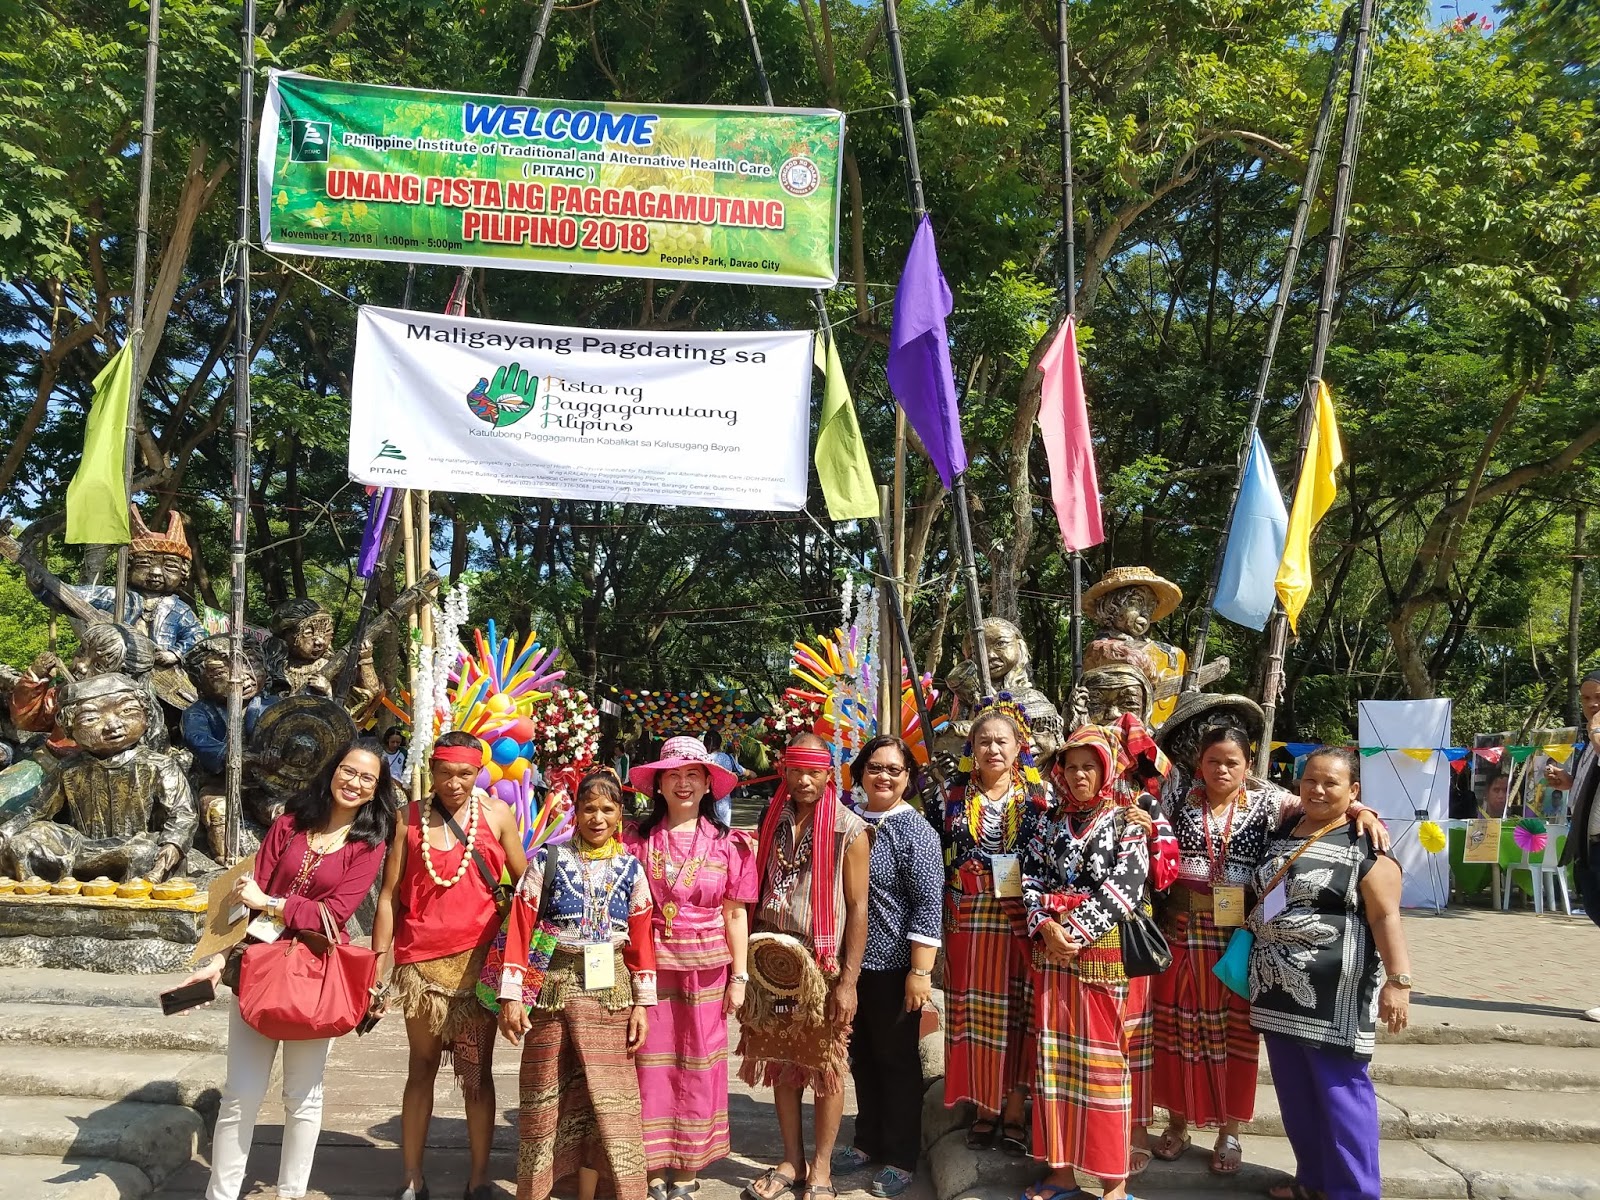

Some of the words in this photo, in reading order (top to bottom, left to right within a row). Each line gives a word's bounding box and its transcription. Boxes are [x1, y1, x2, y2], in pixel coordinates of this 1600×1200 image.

[465, 103, 657, 145] WELCOME
[344, 134, 412, 151] Philippine
[418, 138, 477, 154] Institute
[482, 143, 496, 155] of
[500, 145, 575, 161] Traditional
[580, 151, 605, 163] and
[610, 152, 685, 168] Alternative
[690, 158, 734, 172] Health
[739, 161, 770, 175] Care
[327, 170, 419, 202] UNANG
[425, 177, 502, 208] PISTA
[507, 183, 545, 211] NG
[551, 187, 784, 228] PAGGAGAMUTANG
[281, 228, 327, 241] November
[330, 231, 347, 244] 21,
[349, 233, 372, 244] 2018
[383, 235, 419, 249] 1:00pm
[428, 238, 463, 251] 5:00pm
[464, 213, 576, 248] PILIPINO
[582, 220, 648, 250] 2018
[660, 254, 699, 268] People's
[702, 256, 727, 269] Park,
[730, 258, 759, 269] Davao
[762, 259, 780, 272] City
[406, 323, 572, 355] Maligayang
[582, 336, 727, 365] Pagdating
[735, 350, 766, 364] sa
[543, 375, 608, 394] Pista
[615, 385, 643, 403] ng
[541, 412, 633, 436] Pilipino
[542, 394, 738, 426] Paggagamutang
[469, 428, 522, 441] Katutubong
[524, 431, 595, 445] Paggagamutan
[597, 436, 639, 447] Kabalikat
[640, 440, 652, 448] sa
[654, 439, 709, 452] Kalusugang
[711, 443, 741, 454] Bayan
[369, 466, 408, 476] PITAHC
